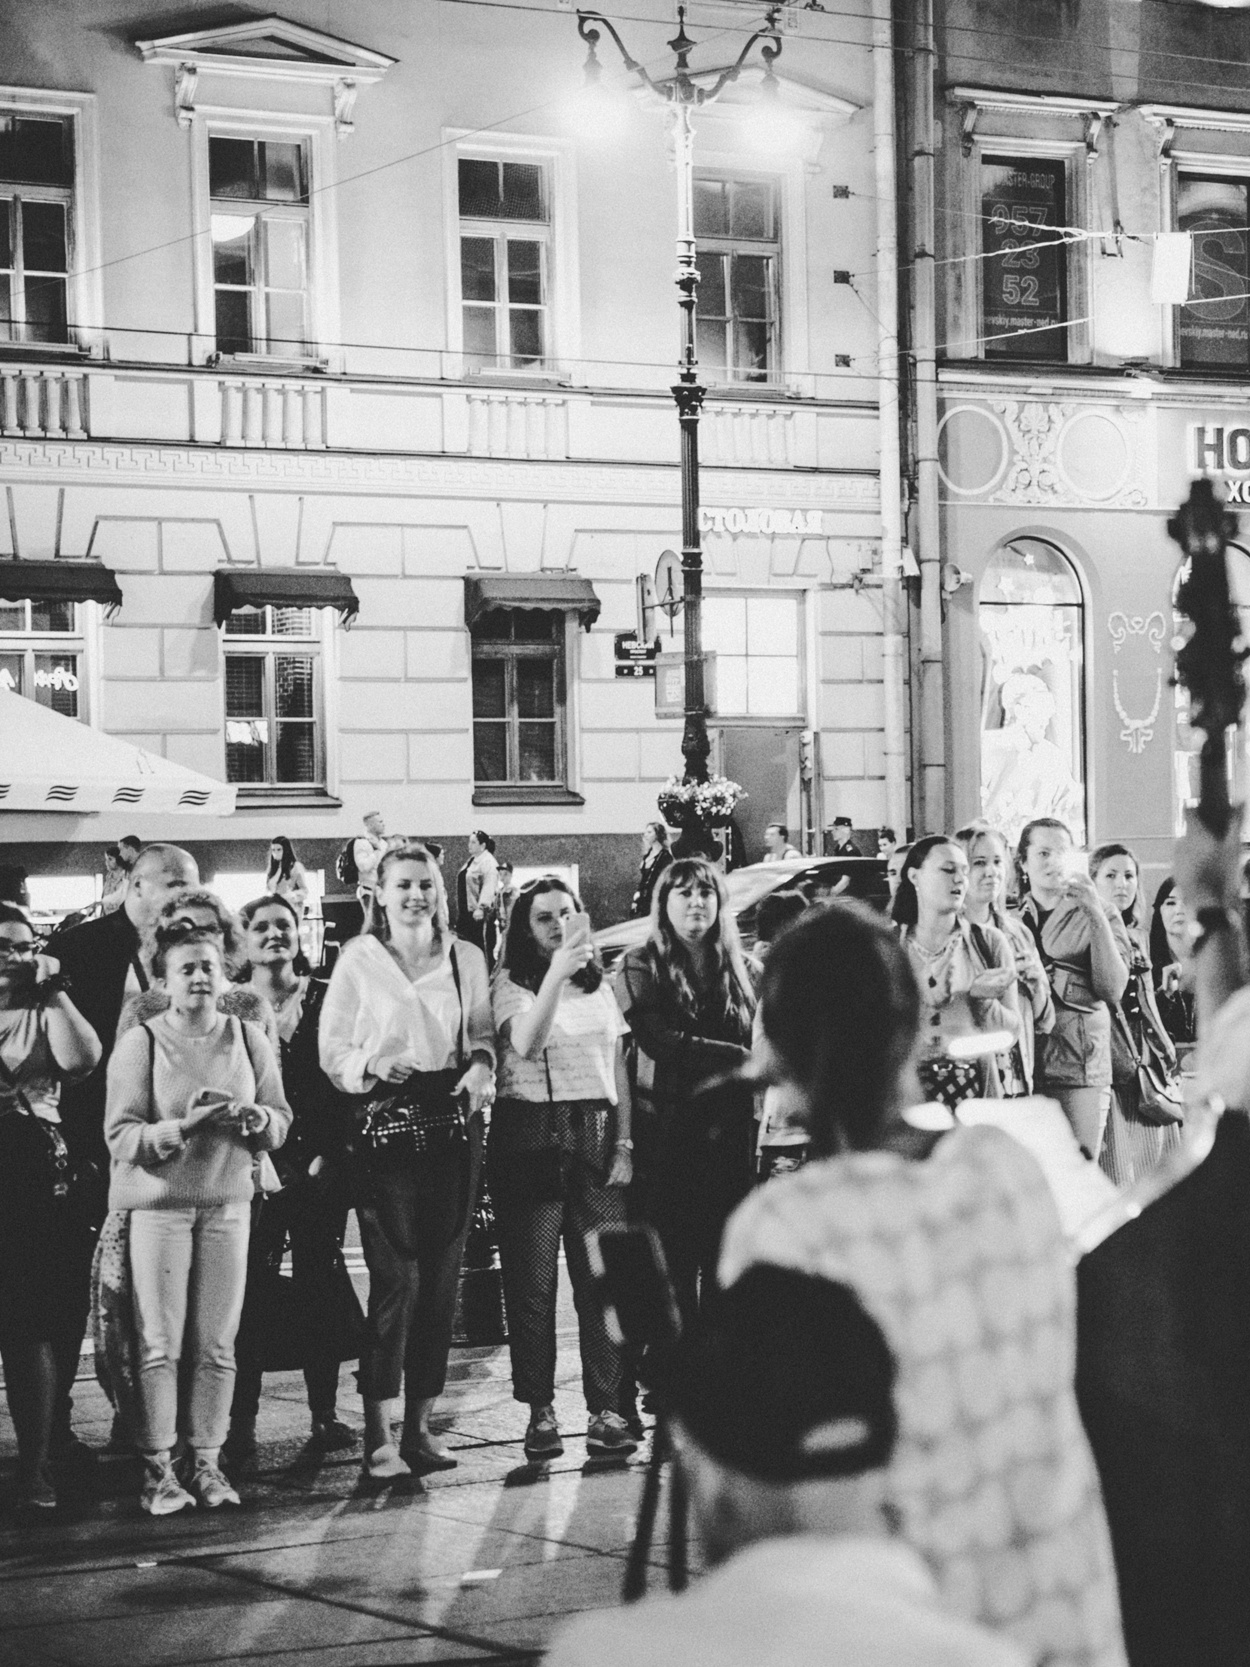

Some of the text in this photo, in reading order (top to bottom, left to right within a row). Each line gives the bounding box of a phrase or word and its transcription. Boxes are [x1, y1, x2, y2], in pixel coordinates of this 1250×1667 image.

[991, 204, 1048, 236] 957
[1001, 238, 1040, 269] 23
[1002, 274, 1040, 306] 52
[698, 506, 823, 535] СТОЛОВАЯ
[633, 665, 644, 676] 25
